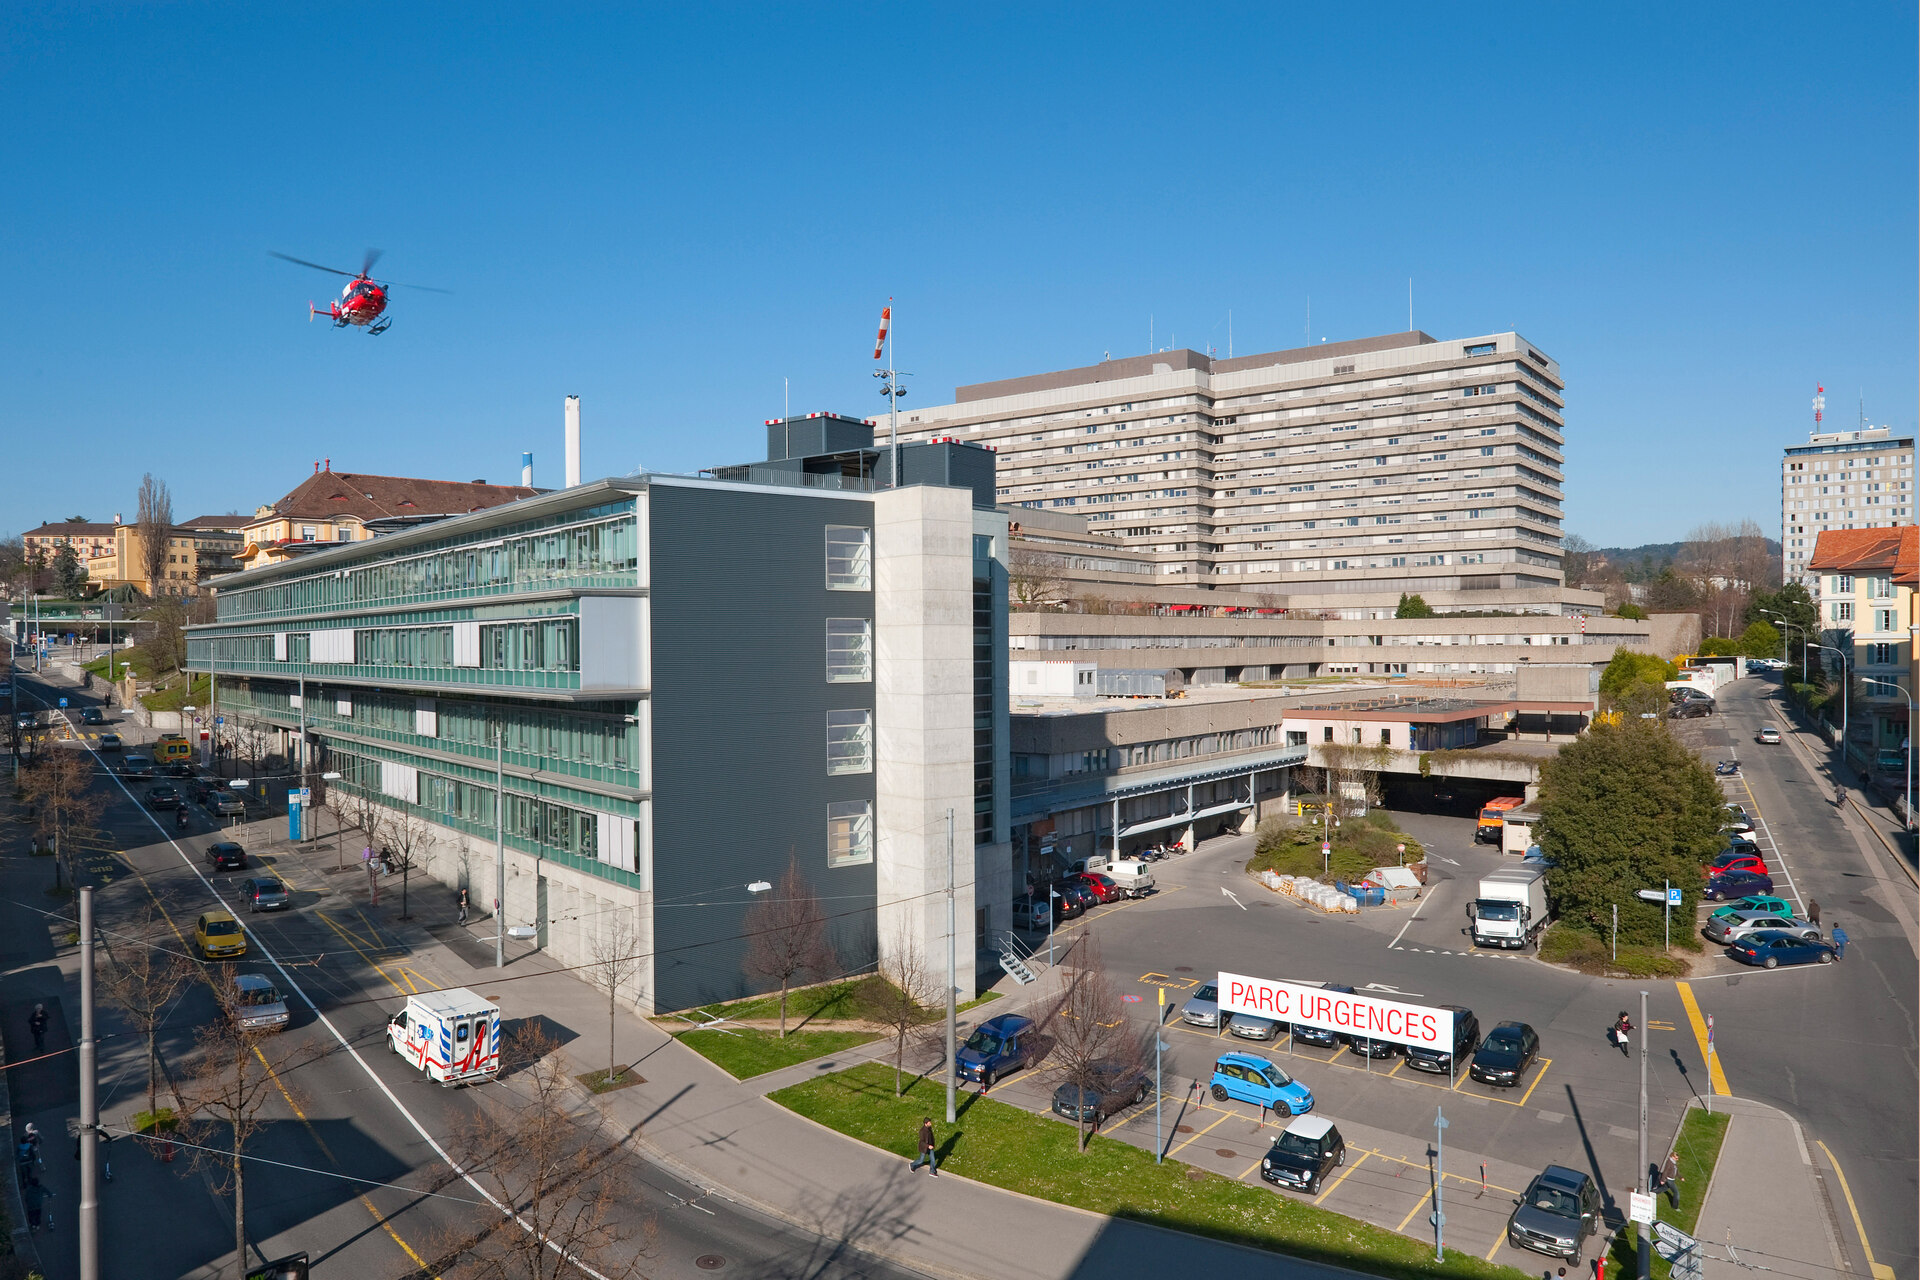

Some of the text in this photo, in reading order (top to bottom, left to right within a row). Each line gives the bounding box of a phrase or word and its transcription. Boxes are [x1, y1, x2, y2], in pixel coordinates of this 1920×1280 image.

[89, 865, 113, 873] BUS
[1671, 891, 1677, 899] P
[1137, 977, 1188, 990] POMPIERS
[1231, 982, 1437, 1042] PARC URGENCES
